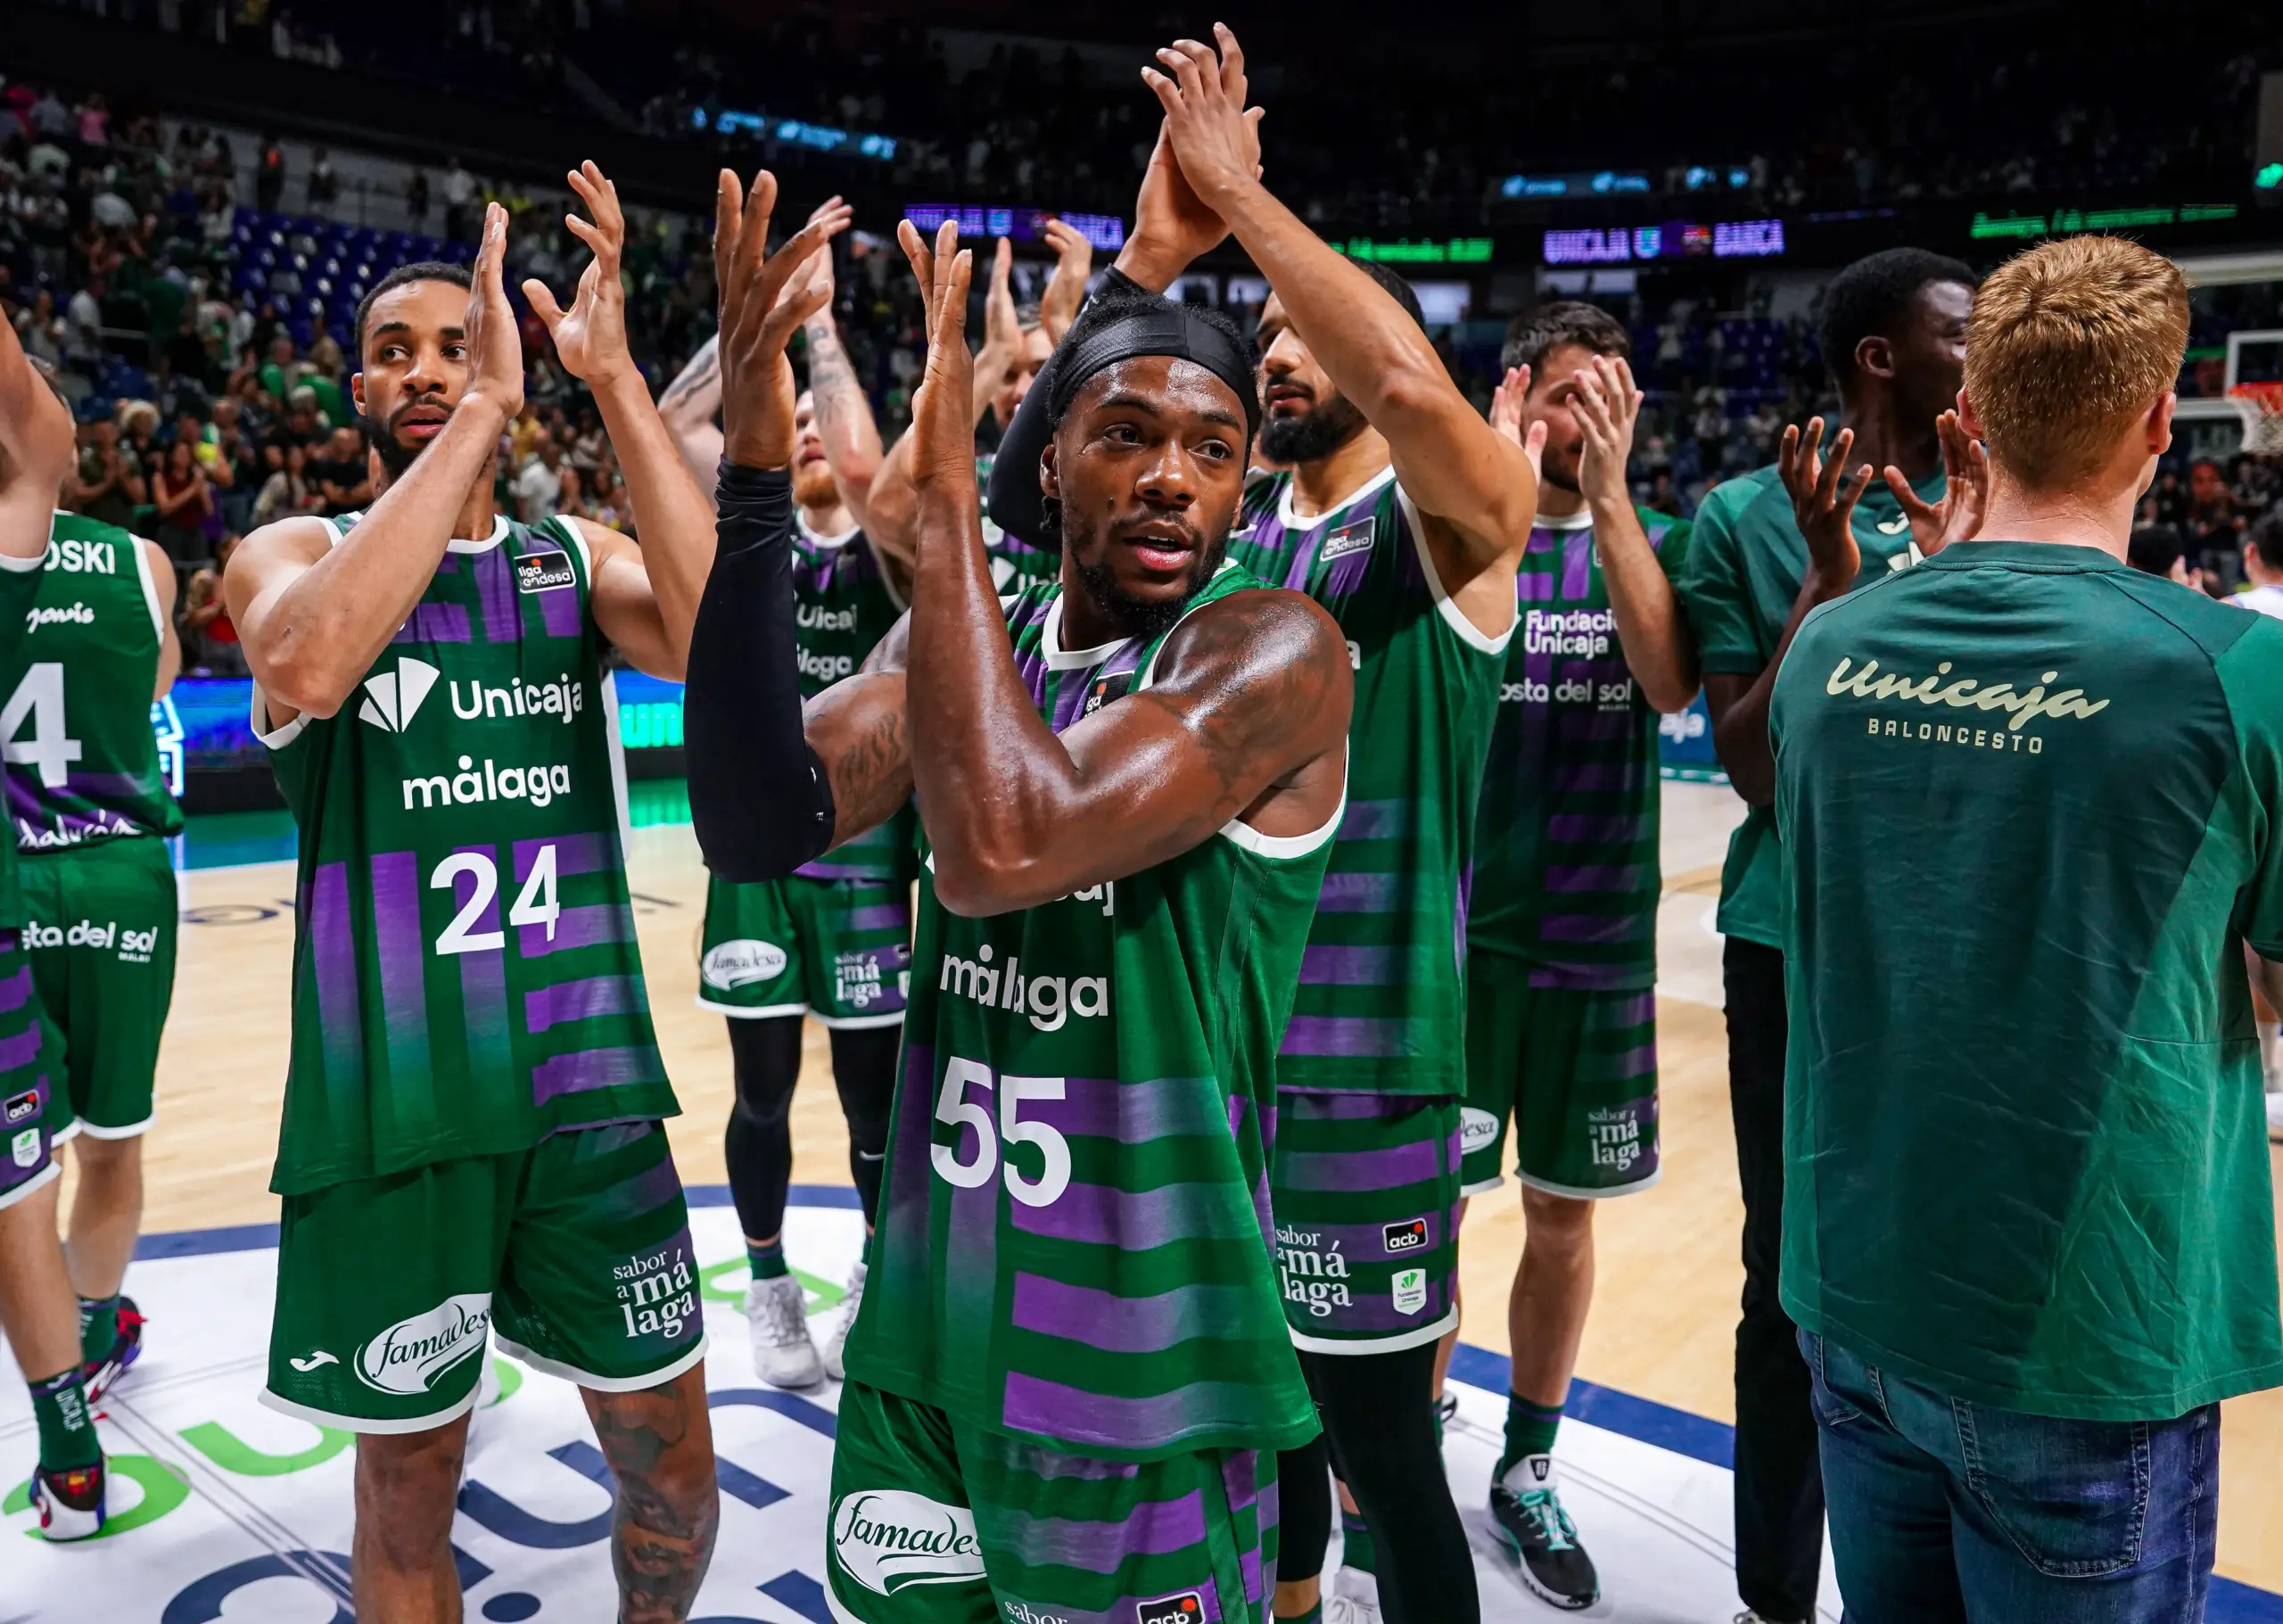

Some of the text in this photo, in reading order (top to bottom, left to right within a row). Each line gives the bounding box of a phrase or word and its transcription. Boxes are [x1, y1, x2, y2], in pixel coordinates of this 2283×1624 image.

[518, 565, 543, 578] liga
[523, 572, 572, 588] endesa
[1526, 608, 1618, 632] Fundaci
[1524, 630, 1609, 660] Unicaja
[449, 672, 583, 724] Unicaja
[1498, 677, 1632, 703] osta del sol
[1826, 656, 2111, 731] Unicaja
[0, 662, 83, 789] 4
[1867, 718, 2043, 754] BALONCESTO
[402, 754, 571, 810] málaga
[430, 844, 560, 956] 24
[67, 919, 116, 949] del
[939, 944, 1109, 1032] málaga
[930, 1055, 1072, 1208] 55
[1587, 1107, 1628, 1122] sabor
[1600, 1110, 1640, 1143] má
[1591, 1138, 1641, 1172] laga
[1275, 1224, 1322, 1247] sabor
[1389, 1232, 1420, 1249] acb
[613, 1250, 667, 1281] sabor
[1277, 1240, 1351, 1278] a má
[616, 1249, 693, 1307] a má
[1280, 1265, 1354, 1317] laga
[620, 1290, 696, 1339] laga
[372, 1303, 490, 1379] famades
[837, 1496, 983, 1557] famades
